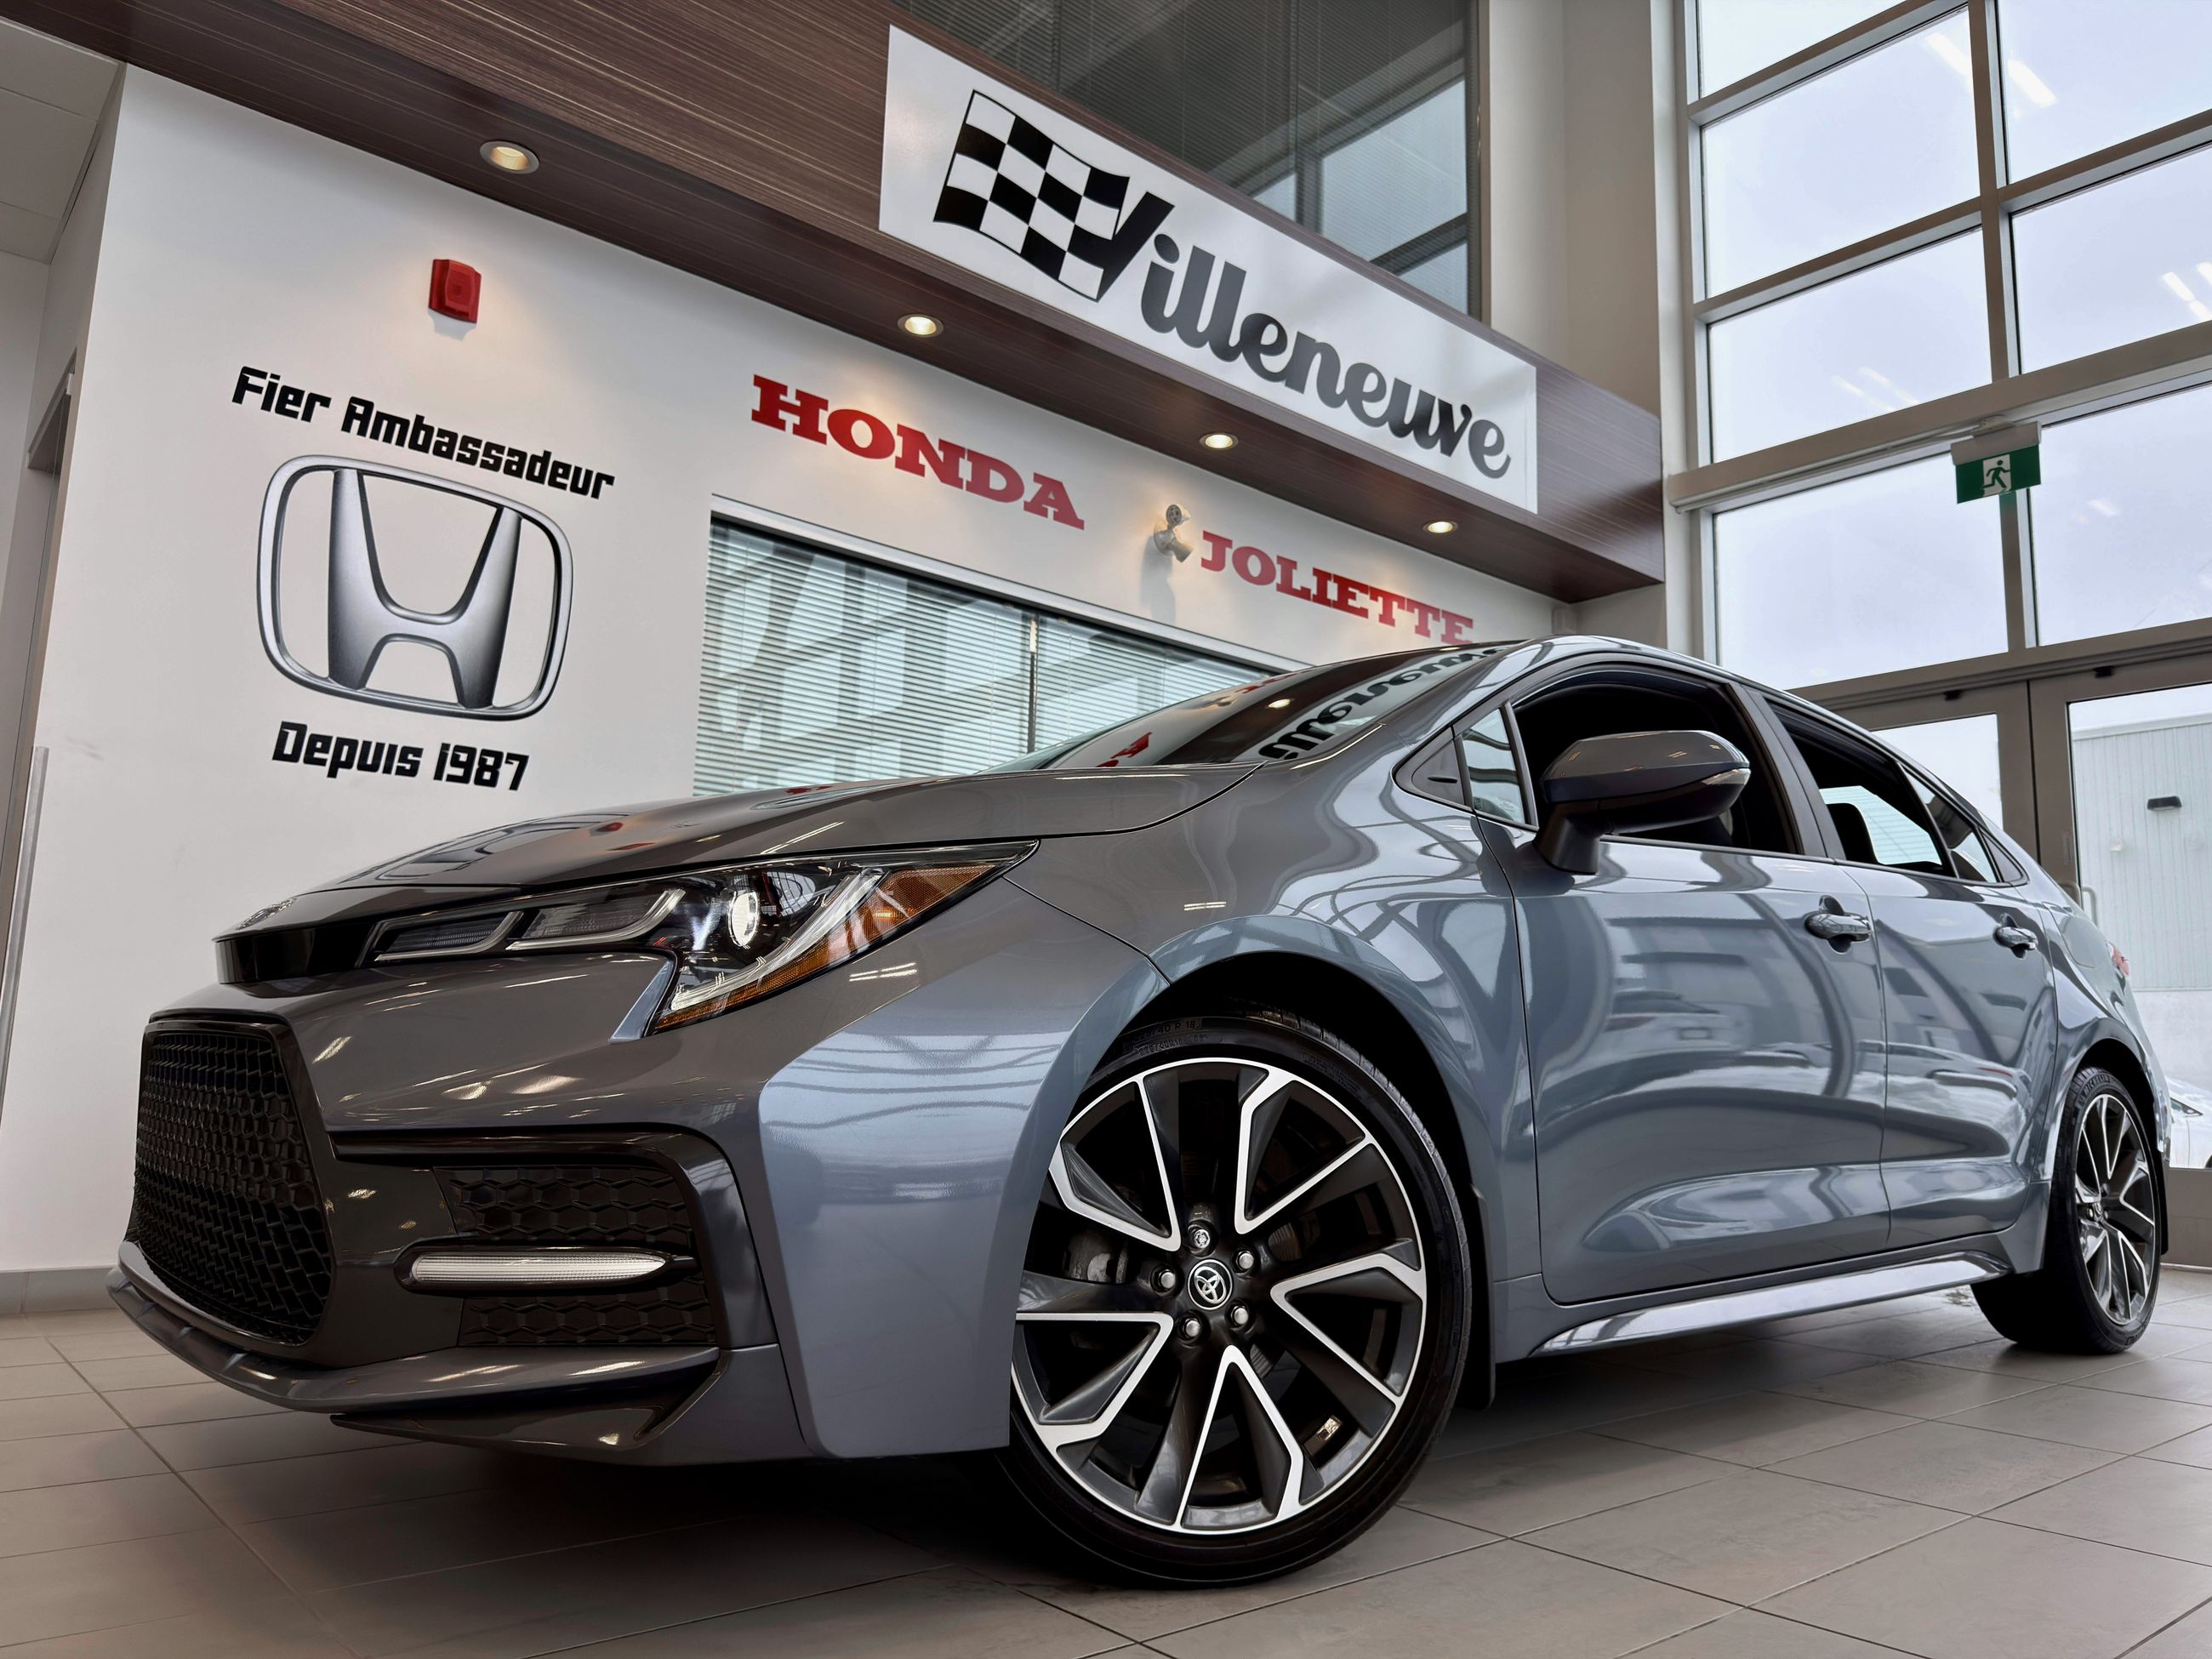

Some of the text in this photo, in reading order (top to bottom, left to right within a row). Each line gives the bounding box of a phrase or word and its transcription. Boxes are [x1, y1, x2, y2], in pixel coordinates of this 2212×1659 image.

[1091, 189, 1513, 479] Villeneuve
[231, 366, 615, 499] Fier Ambassadeur
[750, 374, 1085, 529] HONDA
[1200, 530, 1474, 646] JOLIETTE
[271, 721, 530, 791] Depuis 1987
